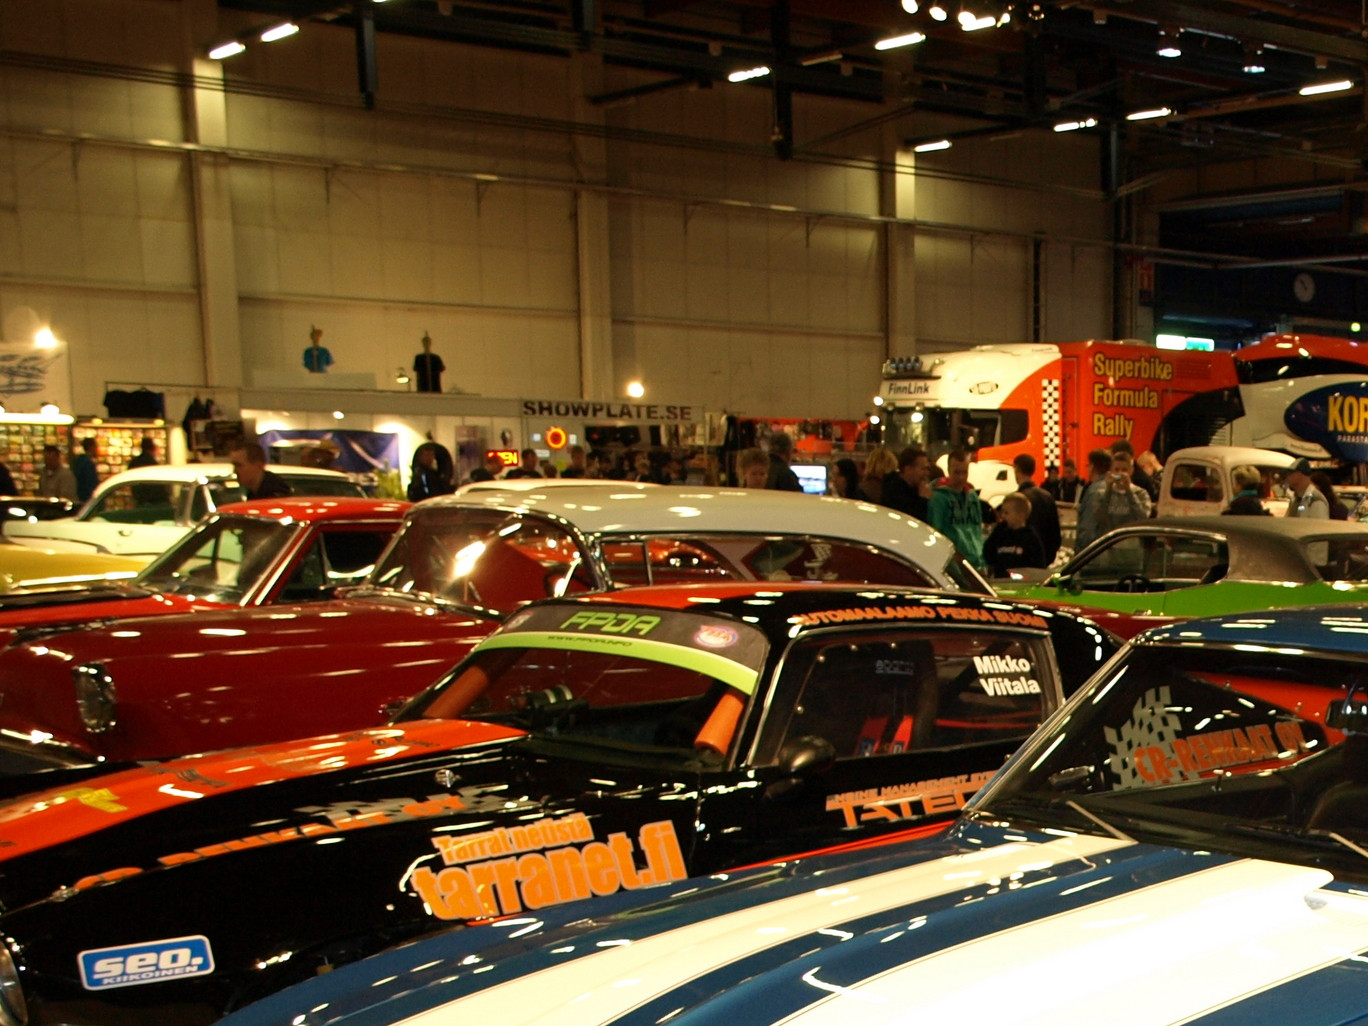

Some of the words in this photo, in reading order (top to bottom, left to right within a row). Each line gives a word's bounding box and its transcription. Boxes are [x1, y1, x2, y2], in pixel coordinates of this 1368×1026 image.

[1094, 353, 1173, 381] Superbike
[888, 382, 930, 395] FinnLink
[1093, 383, 1158, 408] Formula
[523, 401, 692, 420] SHOWPLATE.SE
[1093, 413, 1134, 440] Rally
[560, 611, 661, 636] FPDA
[973, 655, 1031, 675] Mikko
[980, 677, 1041, 698] Viitala
[434, 829, 510, 864] Tarrat
[512, 813, 593, 850] netistä
[412, 821, 688, 919] tarranet.fi
[93, 948, 204, 980] seo.
[102, 965, 200, 985] KIIKOINEN
